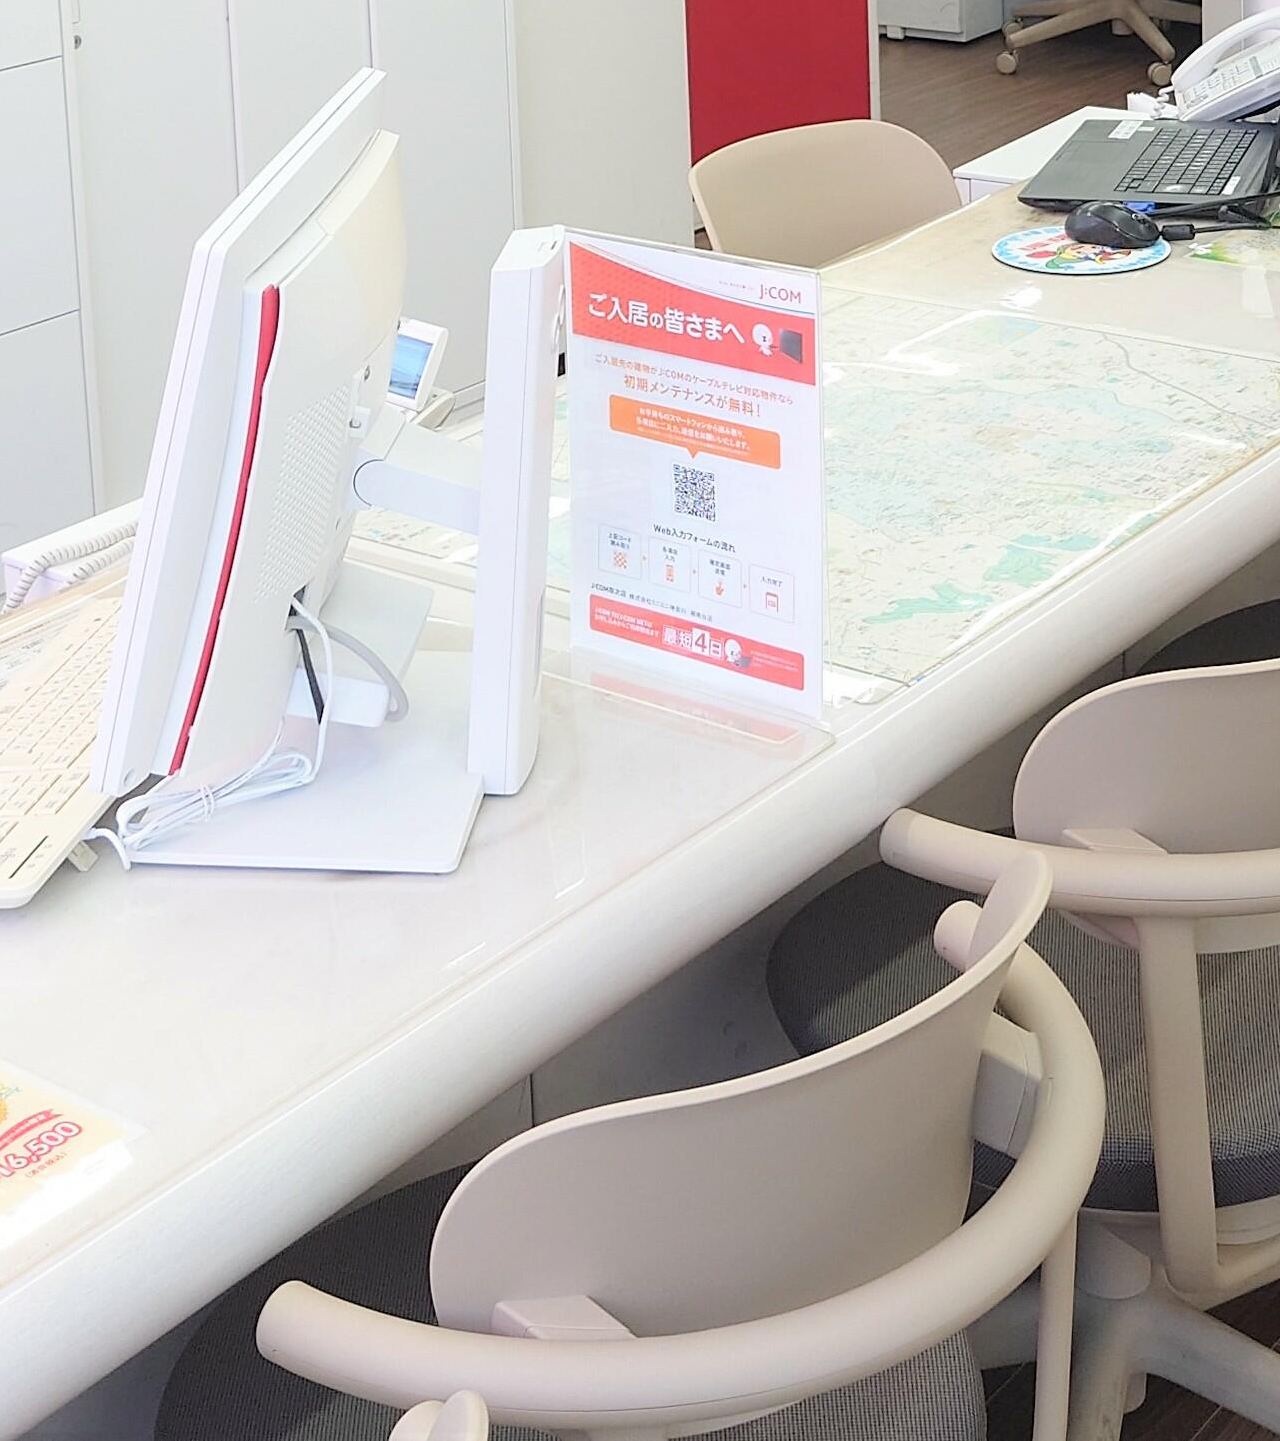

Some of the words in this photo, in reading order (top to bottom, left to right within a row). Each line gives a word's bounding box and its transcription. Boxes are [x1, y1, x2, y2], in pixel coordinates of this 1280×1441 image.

[759, 284, 802, 304] J:COM
[587, 292, 746, 344] ご入居の皆さまへ
[653, 523, 736, 554] Web入力フォームの流れ
